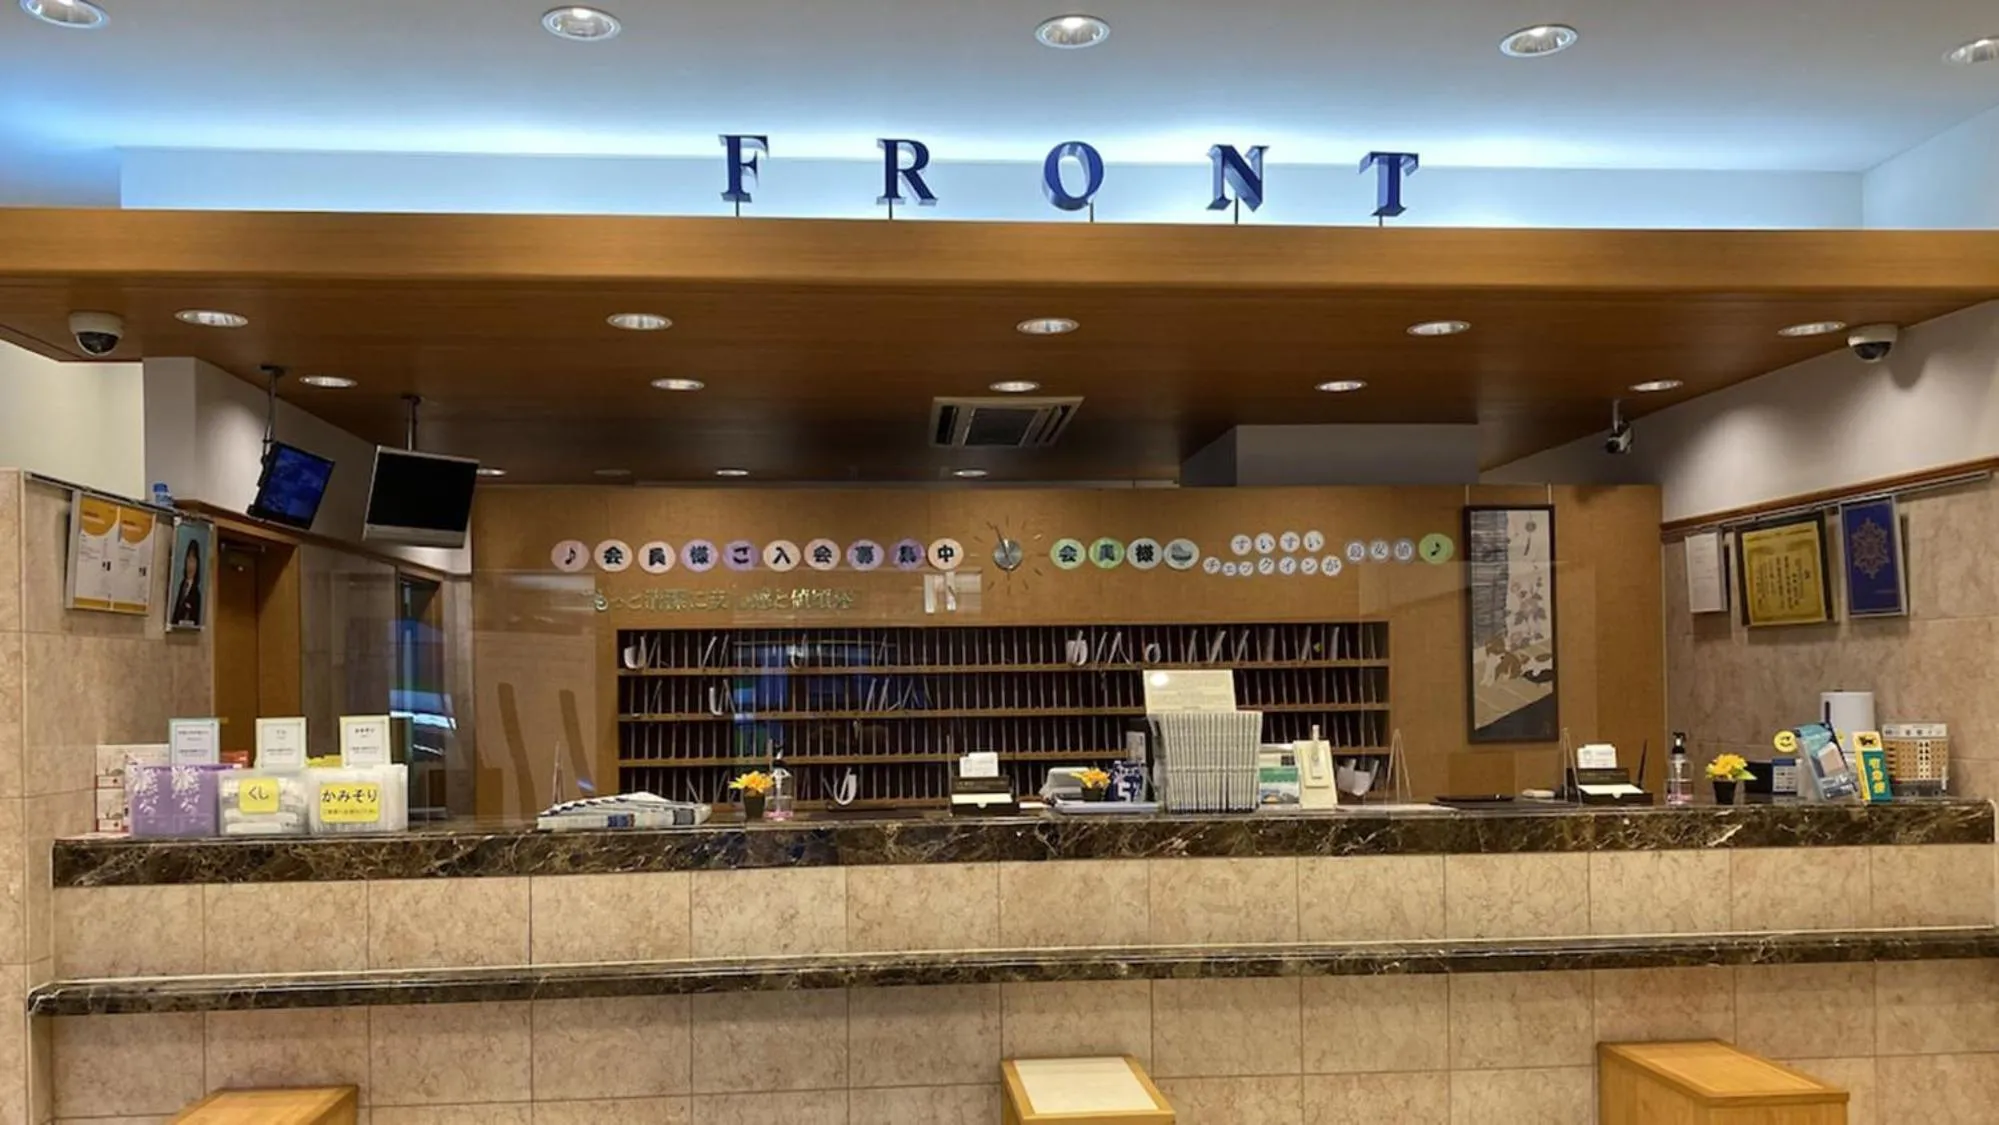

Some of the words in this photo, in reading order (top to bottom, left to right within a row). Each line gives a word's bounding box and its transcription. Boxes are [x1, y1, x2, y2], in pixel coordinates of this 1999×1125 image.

[718, 133, 1420, 217] FRONT
[1058, 543, 1155, 563] 会員様
[248, 784, 270, 800] くし
[321, 788, 378, 804] かみそり
